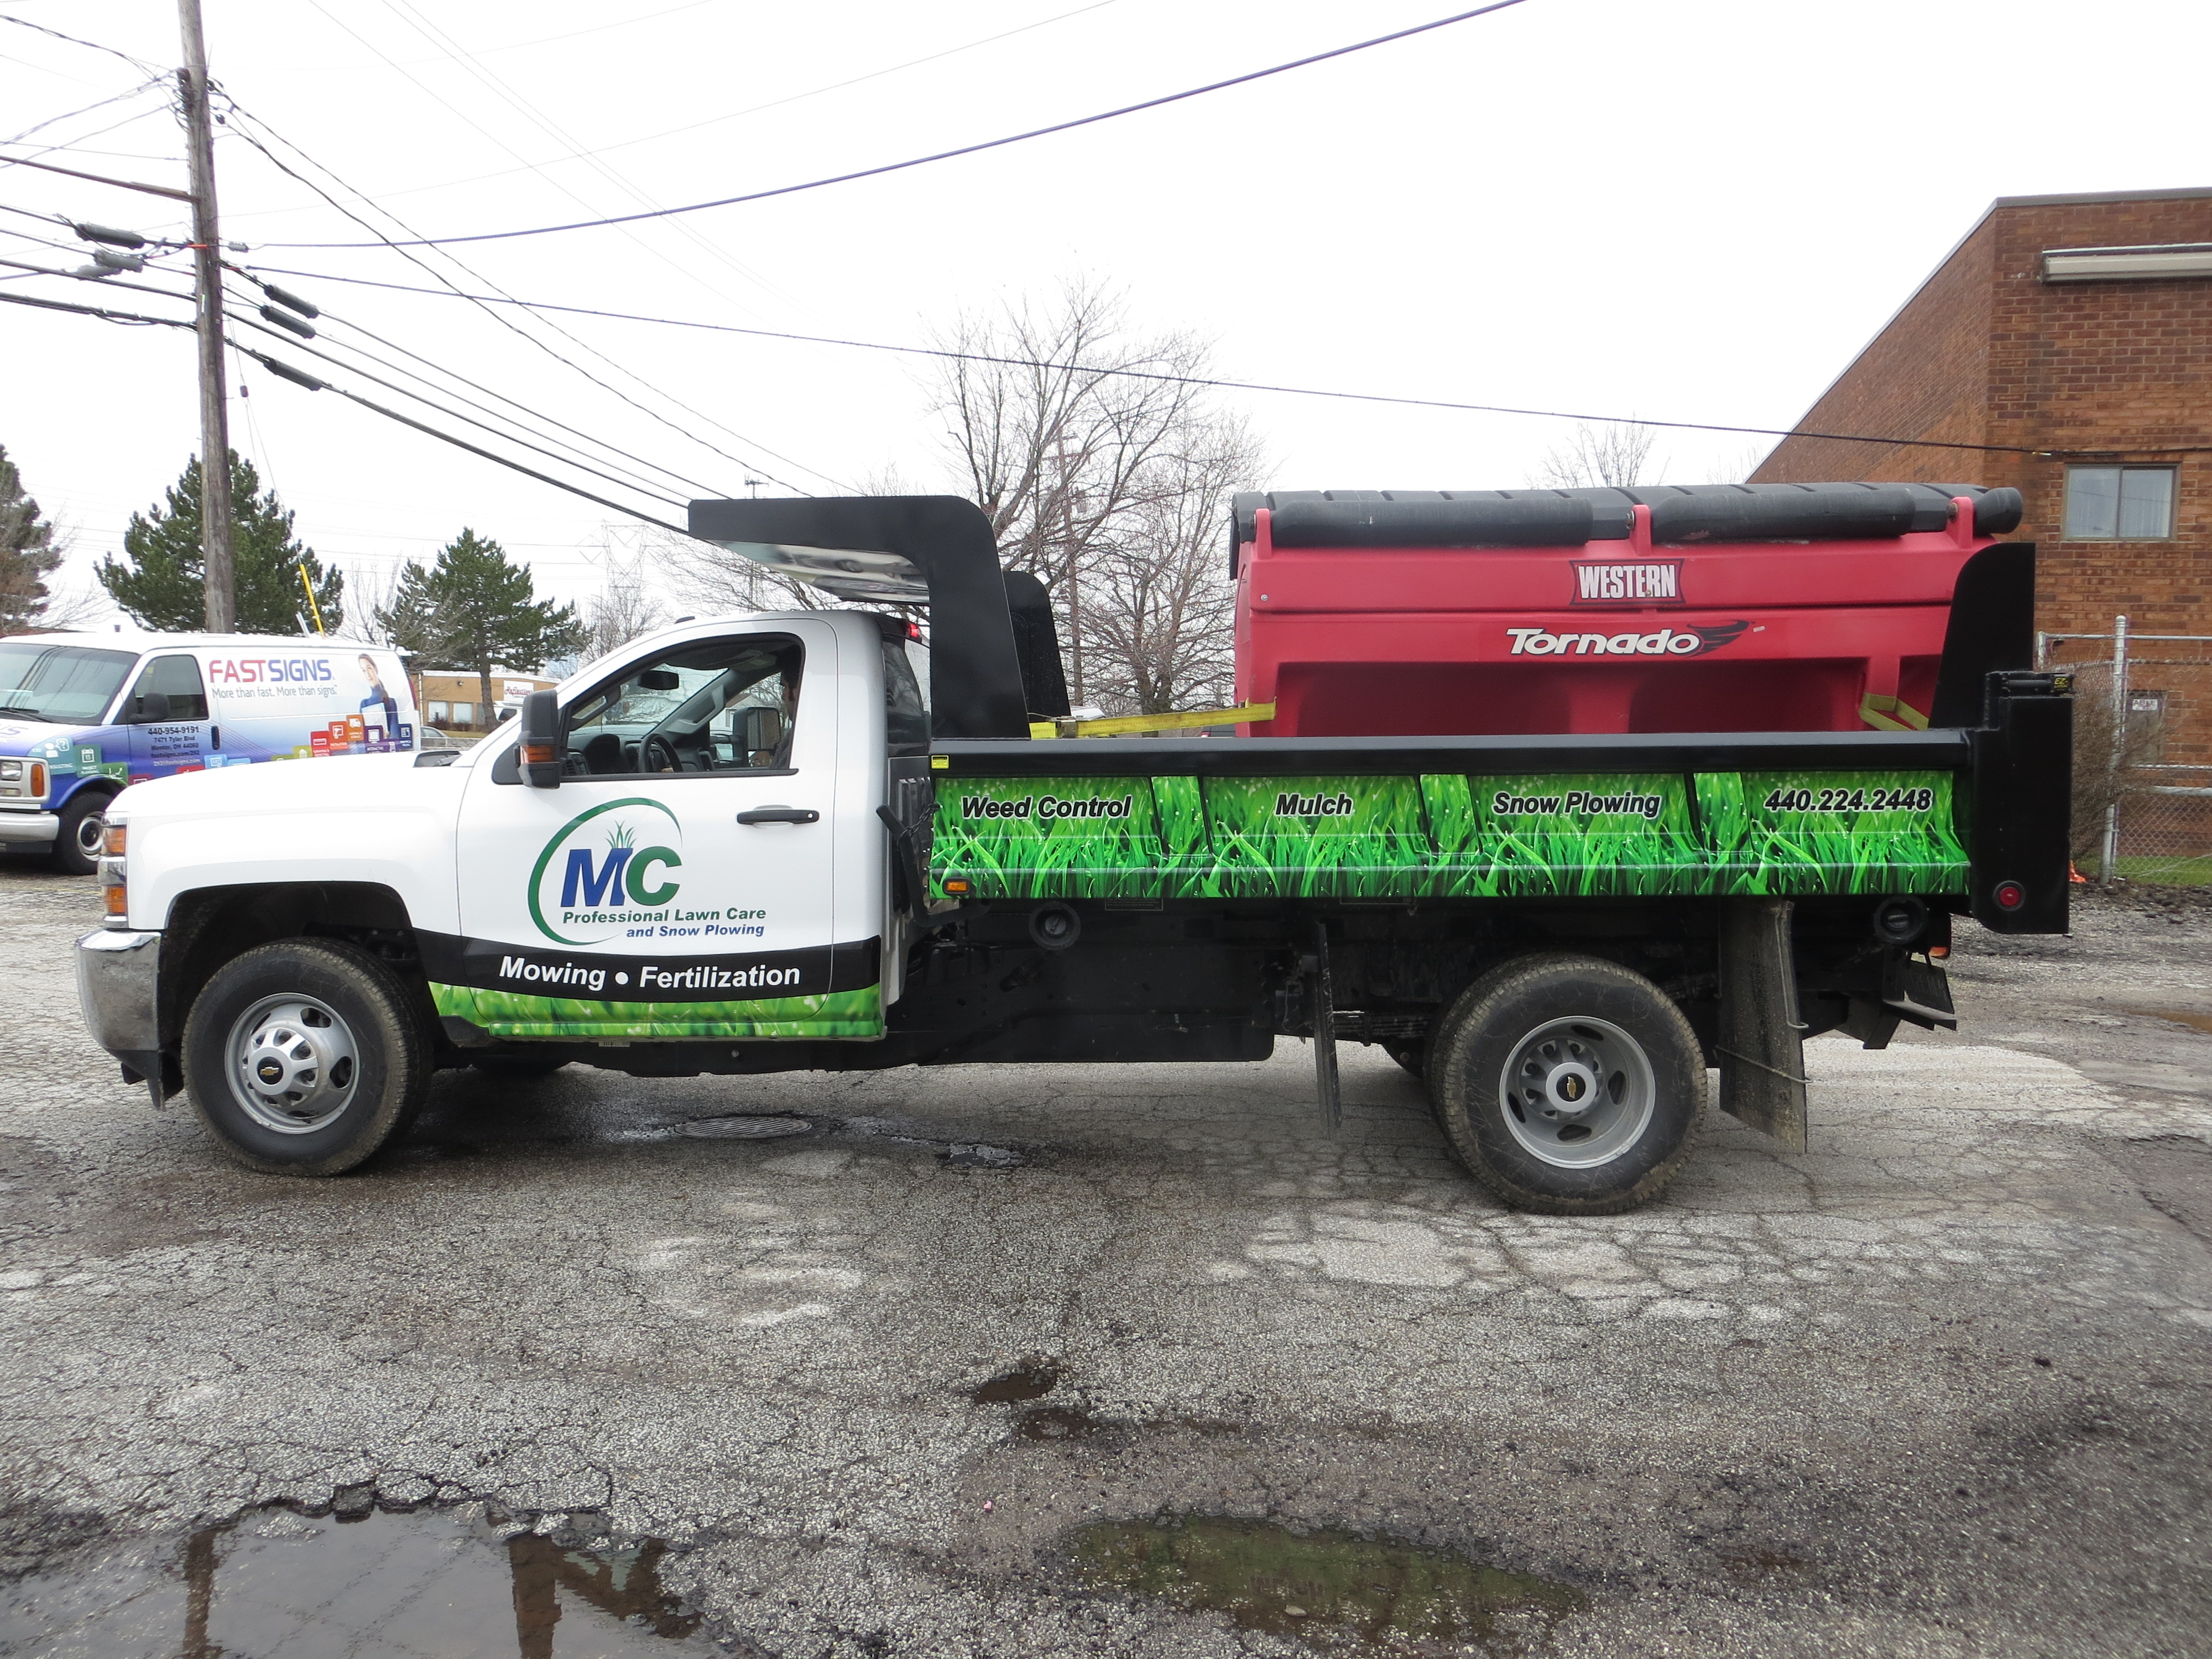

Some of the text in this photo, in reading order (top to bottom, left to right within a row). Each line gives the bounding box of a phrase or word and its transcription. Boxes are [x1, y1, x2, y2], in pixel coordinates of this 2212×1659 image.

[1578, 564, 1676, 598] WESTERN
[1506, 628, 1700, 655] Tornado
[212, 687, 234, 698] More
[236, 686, 255, 697] than
[257, 686, 275, 697] fast.
[276, 686, 296, 696] More
[298, 685, 316, 696] than
[148, 726, 199, 735] 440-954-9191
[962, 795, 1133, 820] Weed Control
[1275, 792, 1354, 816] Mulch
[1493, 790, 1661, 819] Snow Plowing
[1764, 787, 1933, 812] 440.224.2448
[560, 846, 682, 907] MC
[562, 907, 767, 924] Professional Lawn Care
[626, 923, 765, 938] and Snow Plowing
[499, 956, 801, 992] Mowing Fertilization
